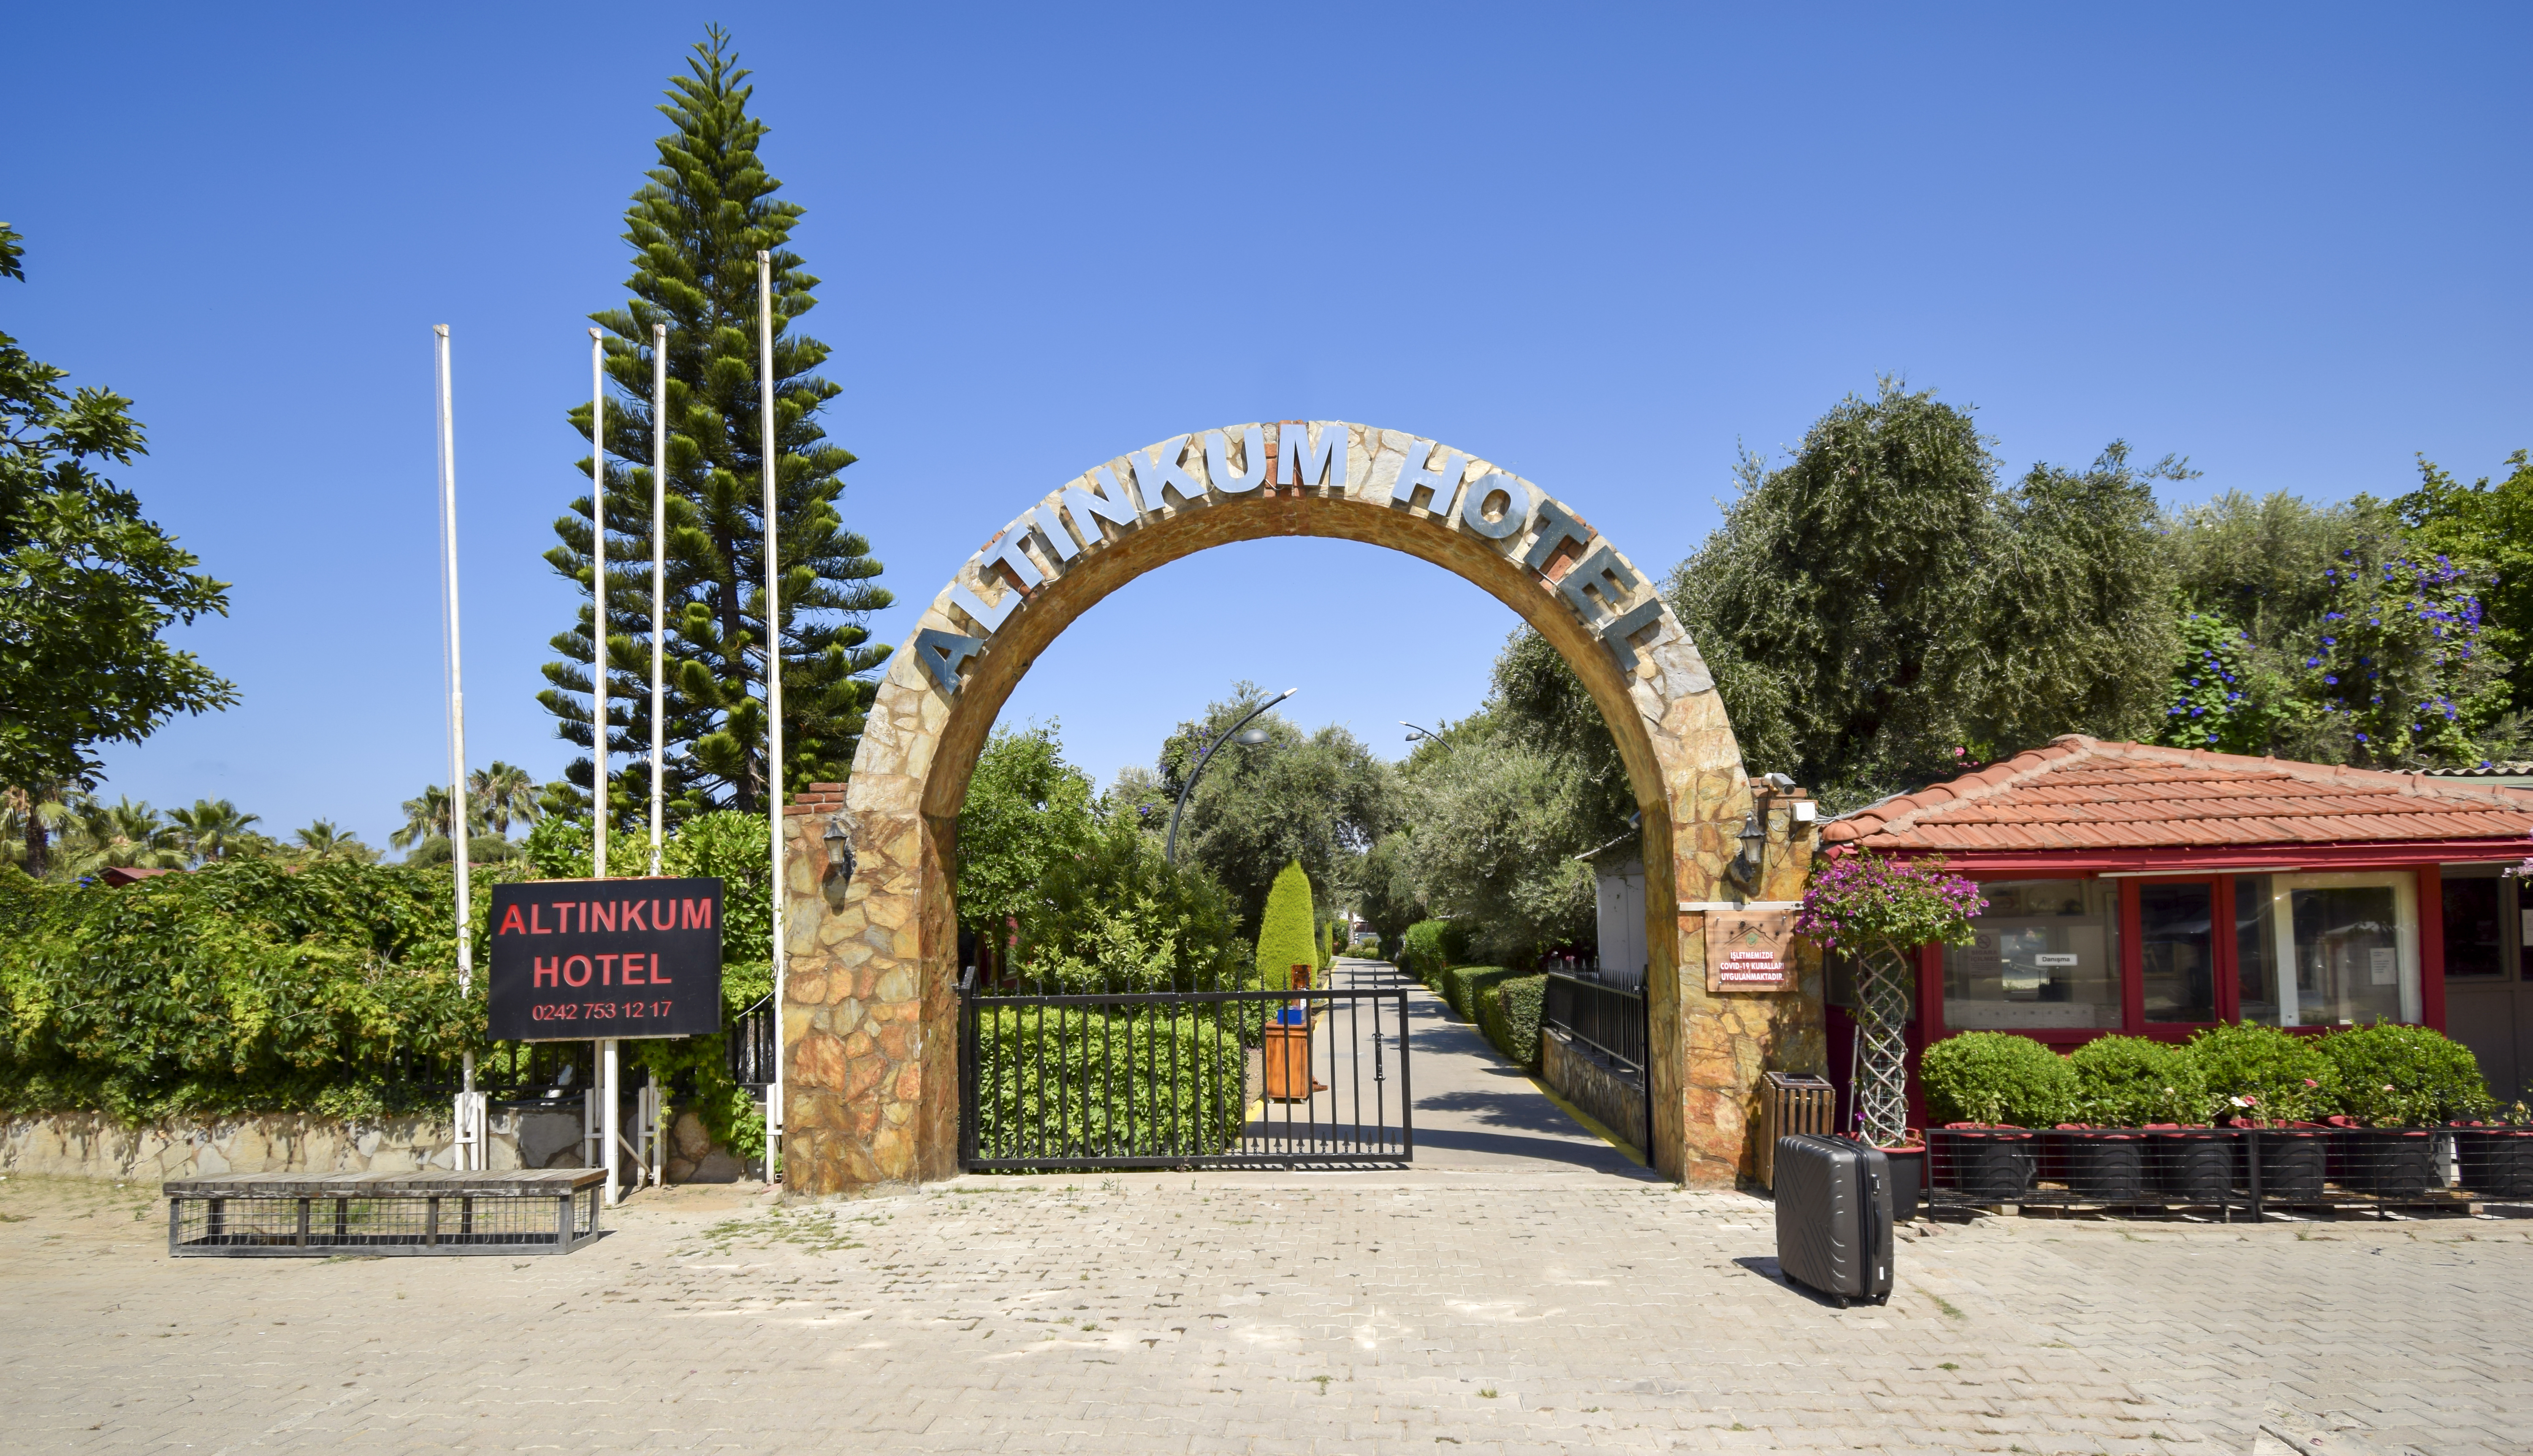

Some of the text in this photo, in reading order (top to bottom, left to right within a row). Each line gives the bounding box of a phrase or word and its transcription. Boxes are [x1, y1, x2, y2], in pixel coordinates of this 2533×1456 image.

[914, 422, 1665, 694] ALTINKUM HOTEL
[499, 897, 712, 935] ALTINKUM
[534, 953, 672, 988] HOTEL
[1730, 950, 1774, 961] İŞLETMEMİZDE
[533, 1000, 673, 1021] 0242 753 12 17
